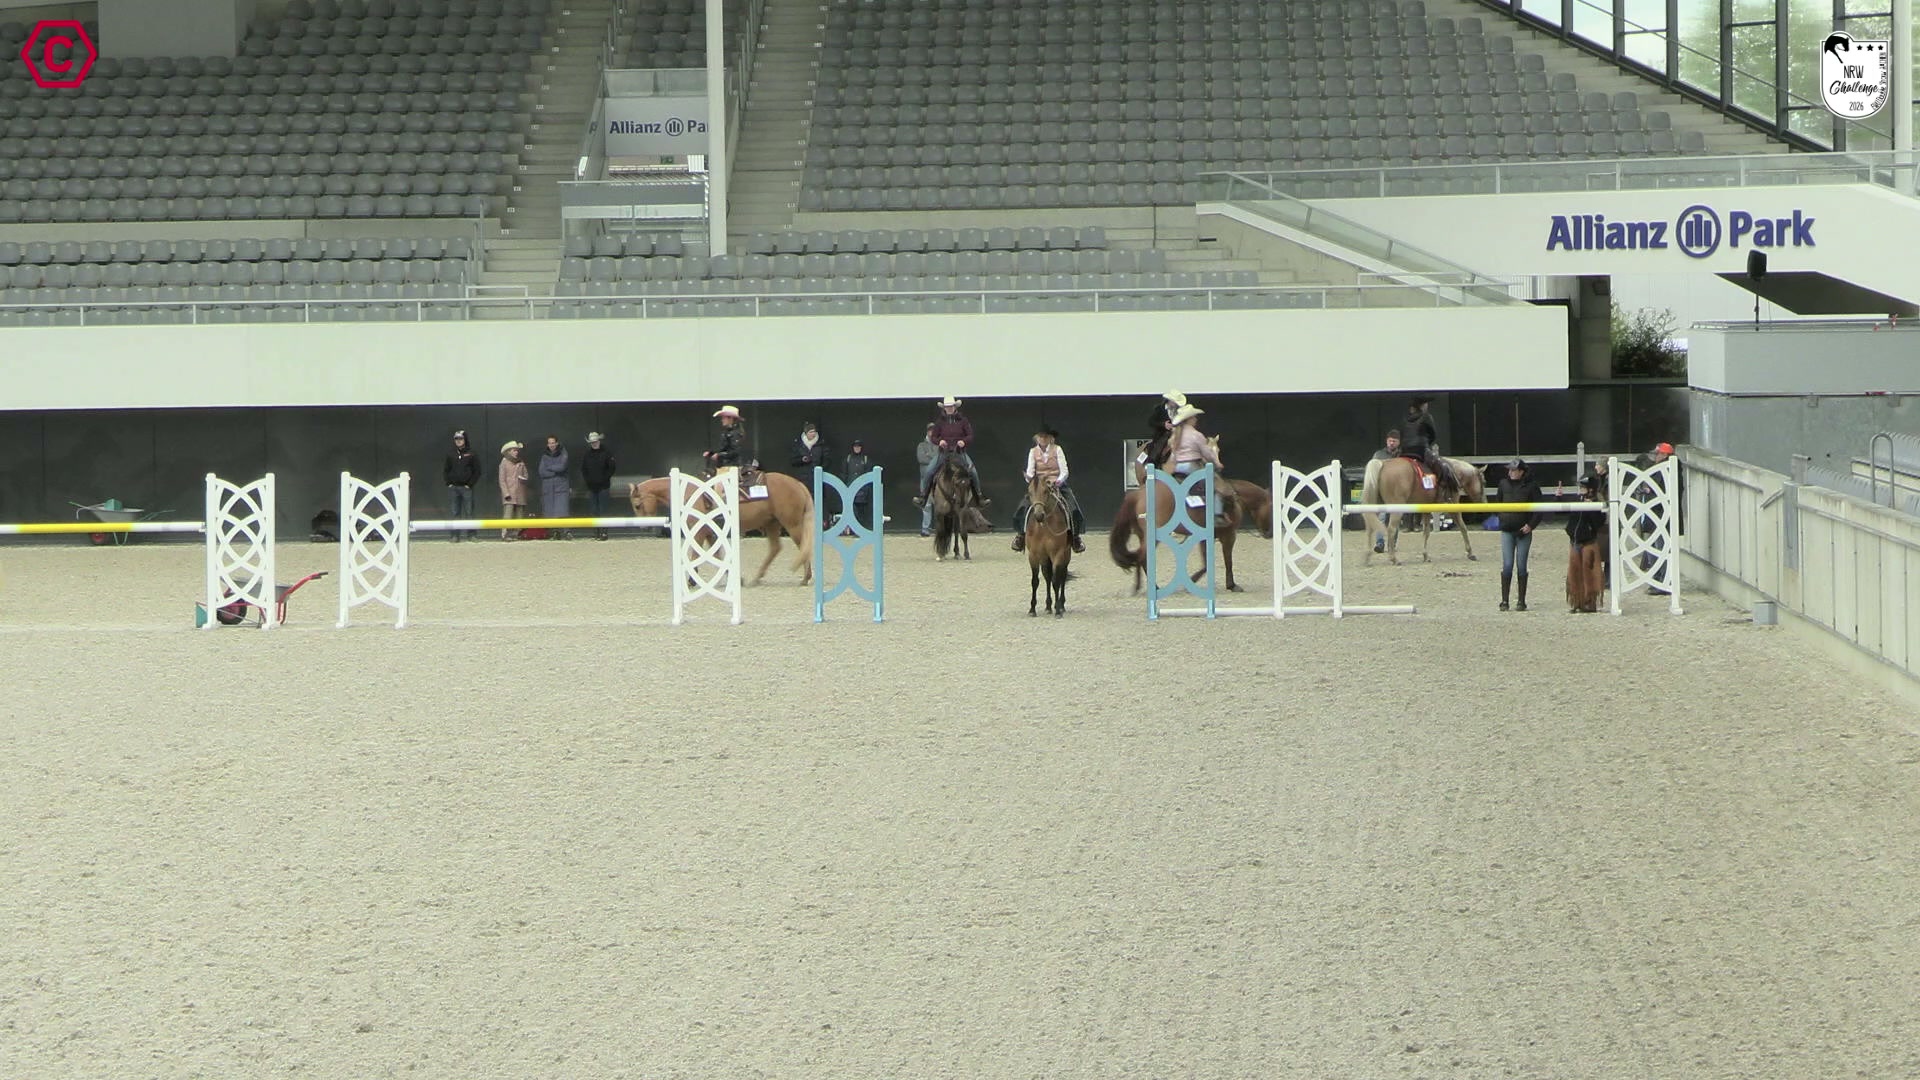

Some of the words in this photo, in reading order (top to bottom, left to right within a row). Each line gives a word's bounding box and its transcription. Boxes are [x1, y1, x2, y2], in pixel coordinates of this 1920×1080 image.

[609, 120, 661, 134] Allianz
[687, 120, 709, 133] Pa
[1546, 214, 1668, 250] Allianz
[1729, 210, 1816, 247] Park
